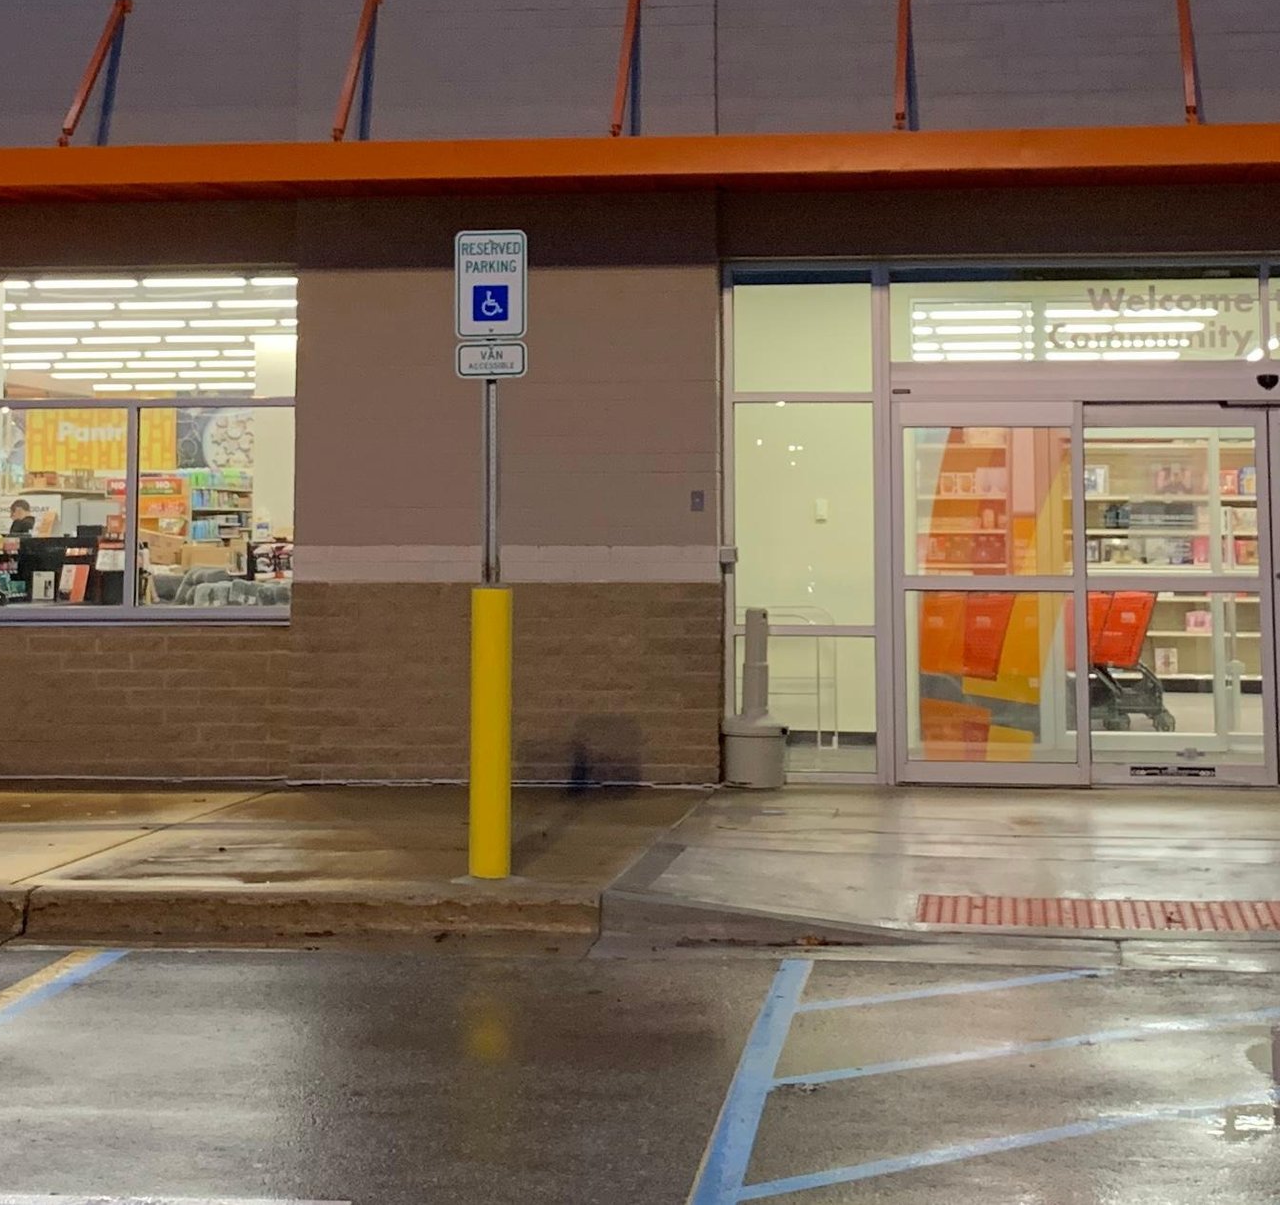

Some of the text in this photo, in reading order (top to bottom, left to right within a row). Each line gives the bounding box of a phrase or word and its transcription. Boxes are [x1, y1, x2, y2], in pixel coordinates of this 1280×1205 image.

[461, 241, 521, 256] RESERVED
[465, 259, 517, 274] PARKING
[1086, 284, 1255, 312] Welcome
[480, 350, 504, 361] VAN
